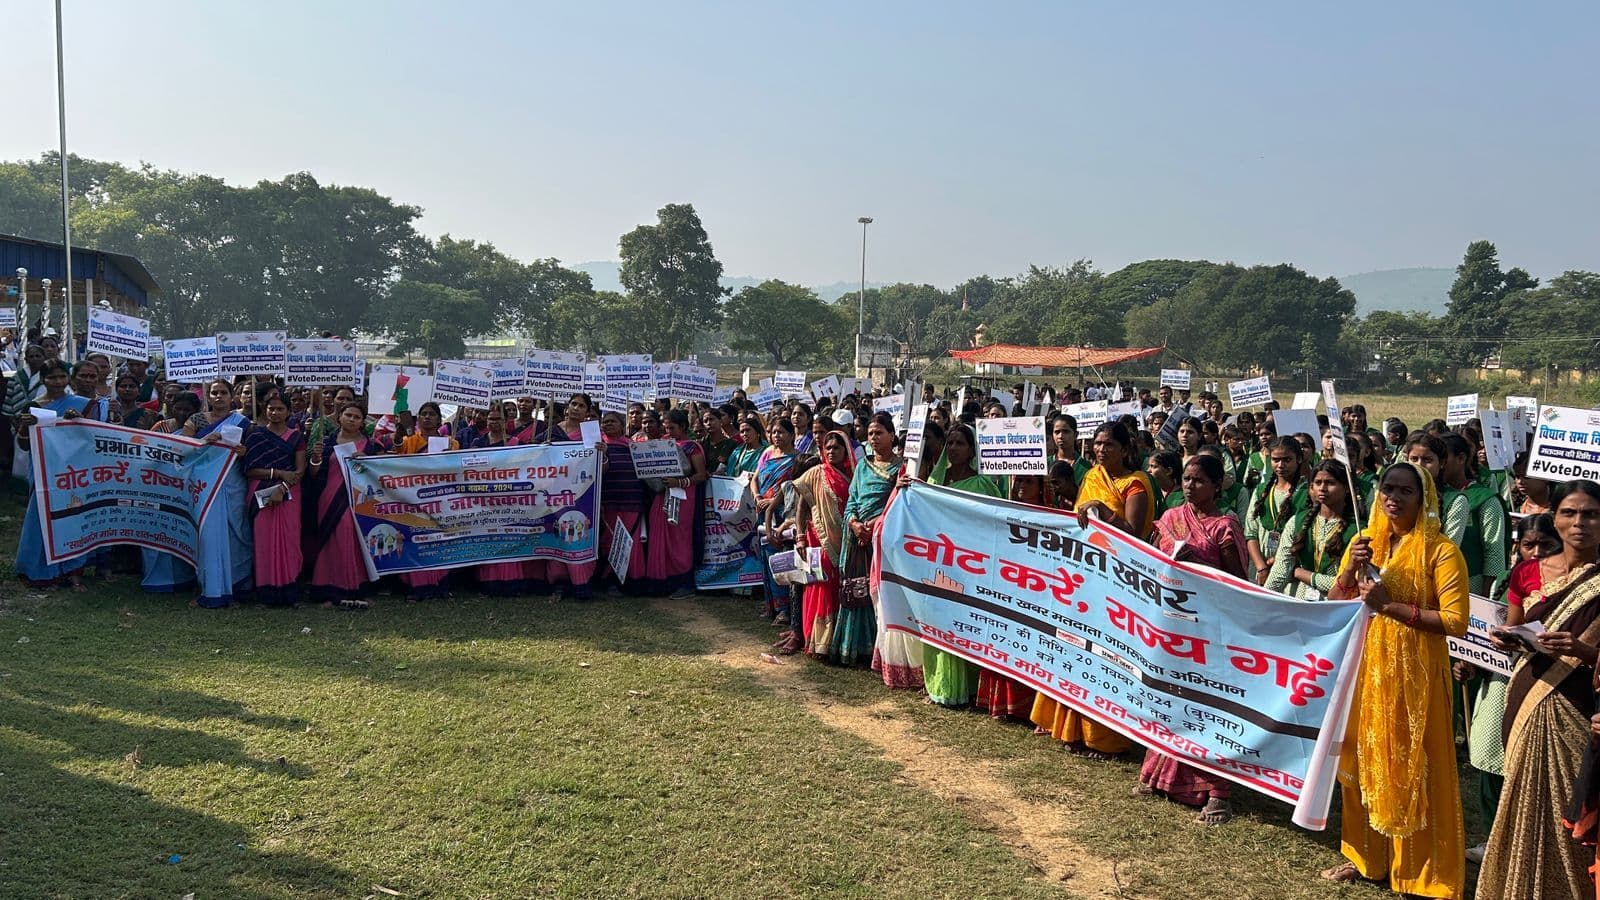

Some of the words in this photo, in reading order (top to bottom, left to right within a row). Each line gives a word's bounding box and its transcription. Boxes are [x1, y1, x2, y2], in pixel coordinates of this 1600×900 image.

[88, 341, 147, 358] #VoteDeneChalo
[169, 366, 218, 377] #VoteDeneC
[287, 374, 353, 383] #VoteDeneChalo
[525, 380, 583, 391] #VoteDeneChalo
[607, 381, 651, 389] oteDeneChalo
[433, 392, 489, 406] #VoteDeneChalo
[671, 390, 714, 400] #VoteDeneChalo
[1028, 434, 1045, 444] 2024
[1539, 425, 1567, 441] विधान
[1569, 431, 1589, 444] सभा
[94, 438, 142, 456] प्रभात
[143, 445, 186, 467] खबर
[979, 461, 1045, 470] #VoteDeneChalo
[54, 465, 89, 491] वोट
[91, 460, 133, 486] करें,
[140, 468, 185, 490] राज्य
[378, 472, 457, 490] विधानसभा
[462, 467, 521, 483] निर्वाचन
[526, 465, 569, 479] 2024
[493, 483, 513, 492] 2024
[374, 502, 443, 517] मतदाता
[447, 493, 537, 510] जागरूकता
[1006, 522, 1107, 574] प्रभात
[1112, 554, 1198, 614] खबर
[903, 533, 991, 575] वोट
[999, 566, 1091, 614] करें,
[1105, 595, 1211, 665] राज्य
[1226, 644, 1336, 707] गढ़ें
[976, 585, 1013, 604] प्रभात
[1015, 598, 1049, 617] खबर
[1052, 609, 1103, 640] मतदाता
[1104, 632, 1165, 676] जागरूकता
[1169, 669, 1247, 699] अभियान
[969, 611, 1009, 632] मतदान
[1015, 626, 1031, 640] की
[1037, 633, 1068, 656] तिथि:
[1075, 653, 1093, 667] 20
[1100, 663, 1135, 687] नवम्बर
[1138, 687, 1173, 708] 2024
[1183, 702, 1246, 738] (बुधवार)
[952, 619, 984, 637] सुबह
[990, 632, 1029, 653] 07:00
[1036, 648, 1055, 665] बजे
[1063, 661, 1073, 674] से
[1081, 671, 1120, 695] 05:00
[1126, 691, 1145, 710] बजे
[1149, 707, 1172, 725] तक
[1182, 718, 1207, 736] करें
[1214, 731, 1261, 758] मतदान
[1014, 658, 1055, 683] मांग
[1058, 675, 1091, 700] रहा
[1092, 695, 1211, 760] शत-प्रतिशत
